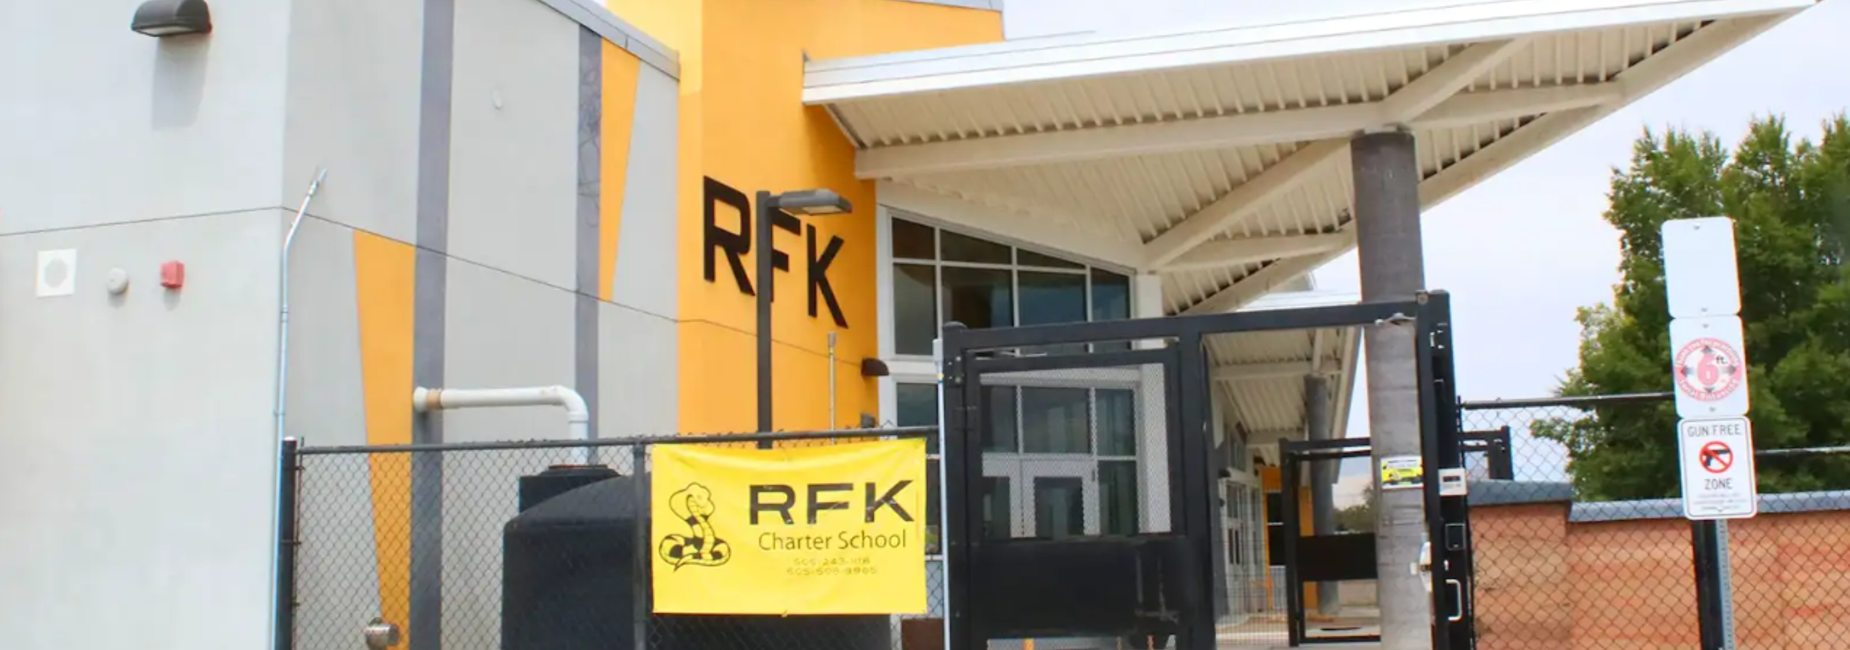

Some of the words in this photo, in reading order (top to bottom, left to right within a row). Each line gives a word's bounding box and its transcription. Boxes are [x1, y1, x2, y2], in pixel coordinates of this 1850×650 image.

[703, 175, 848, 329] RFK
[1697, 354, 1719, 386] 6
[1687, 426, 1709, 437] GUN
[1712, 424, 1741, 436] FREE
[1704, 478, 1733, 490] ZONE
[749, 480, 915, 525] RFK
[758, 532, 832, 551] Charter
[838, 529, 906, 549] School
